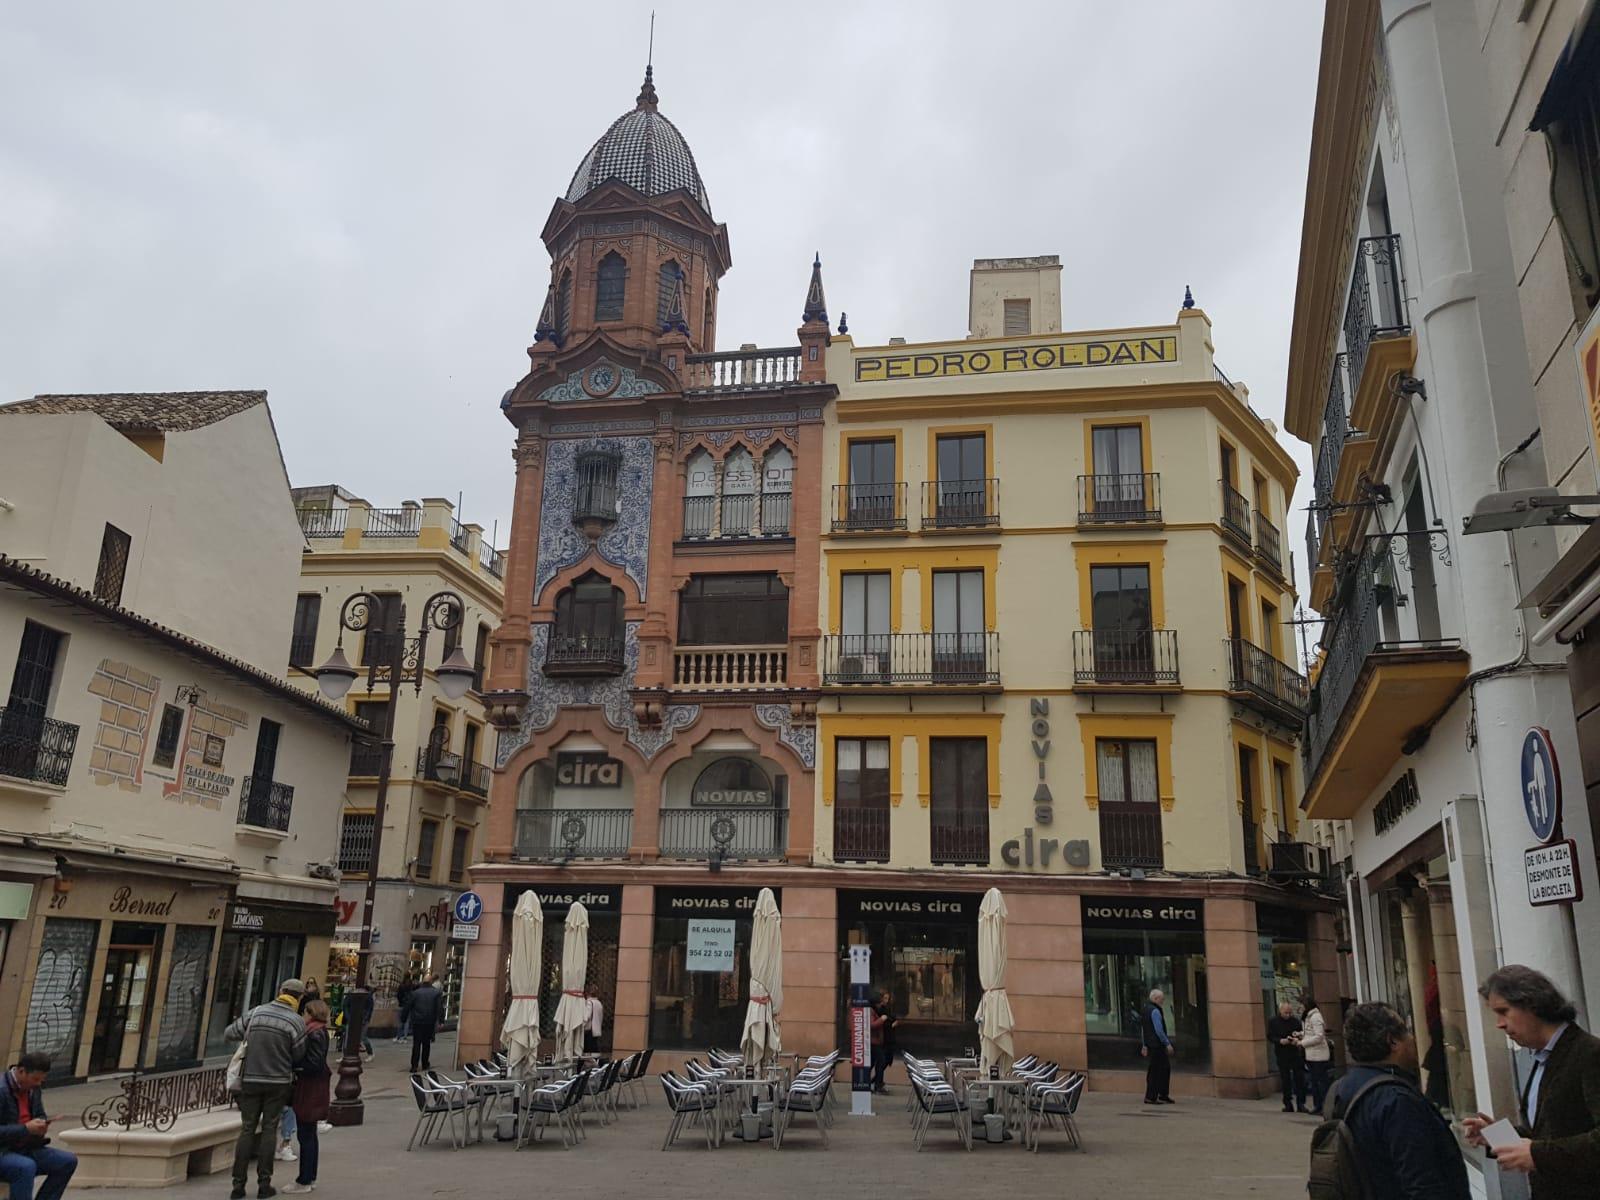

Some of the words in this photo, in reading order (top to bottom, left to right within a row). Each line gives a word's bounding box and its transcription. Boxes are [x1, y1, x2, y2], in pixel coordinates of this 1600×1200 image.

[856, 352, 991, 380] PEDRO
[1002, 339, 1165, 371] ROLDAN
[1030, 698, 1053, 824] NOVIAS
[557, 757, 619, 785] cira
[696, 791, 768, 803] NOVIAS
[1001, 828, 1090, 867] cira
[1527, 855, 1534, 866] DE
[1549, 850, 1554, 862] A
[1555, 849, 1563, 860] 22
[1529, 867, 1561, 882] DESMONTE
[1561, 864, 1571, 877] DE
[578, 892, 610, 905] cira
[1532, 887, 1540, 899] LA
[1541, 882, 1571, 897] BICICLETA
[49, 894, 68, 910] 20
[109, 886, 178, 917] Bernal
[671, 898, 730, 909] NOVIAS
[735, 898, 757, 909] cir
[860, 900, 921, 912] NOVIAS
[927, 899, 962, 913] cira
[207, 907, 221, 920] 20
[1087, 907, 1153, 919] NOVIAS
[1159, 906, 1196, 920] cira
[689, 949, 702, 957] 954
[703, 949, 712, 957] 22
[723, 950, 733, 958] 02
